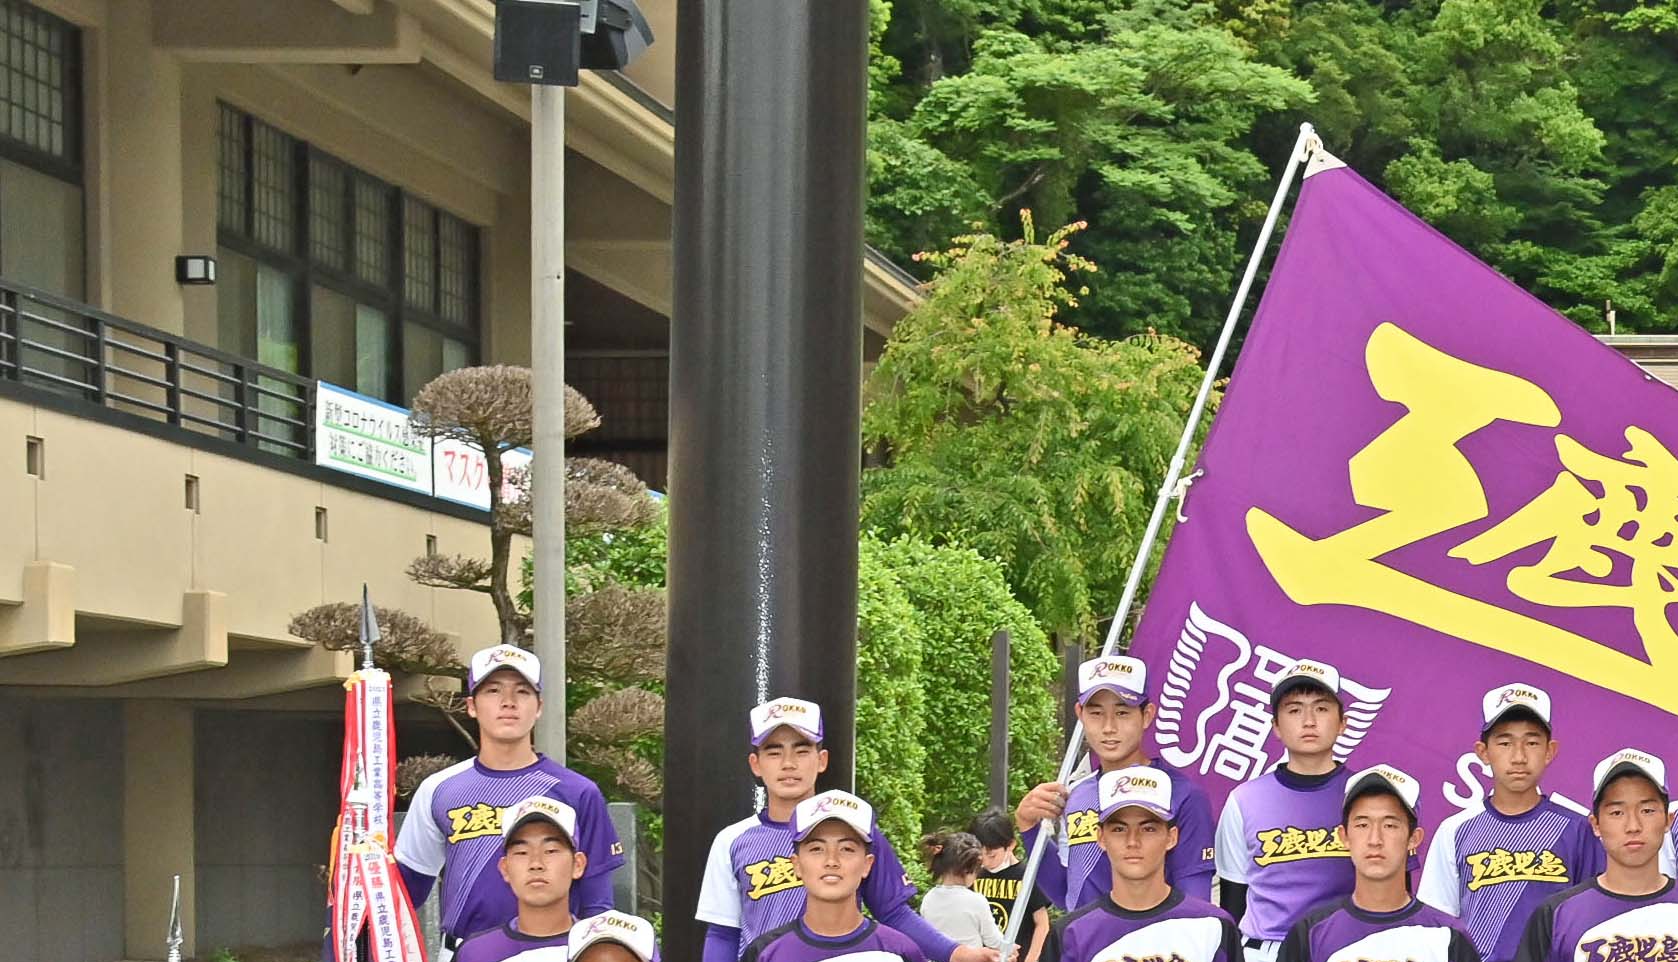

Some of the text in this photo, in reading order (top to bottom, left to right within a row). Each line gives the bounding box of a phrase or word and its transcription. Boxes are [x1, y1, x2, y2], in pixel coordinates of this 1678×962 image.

[1089, 661, 1132, 681] ROKKO
[763, 703, 806, 722] ROKKO
[1110, 775, 1157, 797] ROKKO
[811, 797, 858, 816] ROKKO
[1466, 848, 1570, 892] 工鹿児島
[581, 916, 637, 940] ROKKO
